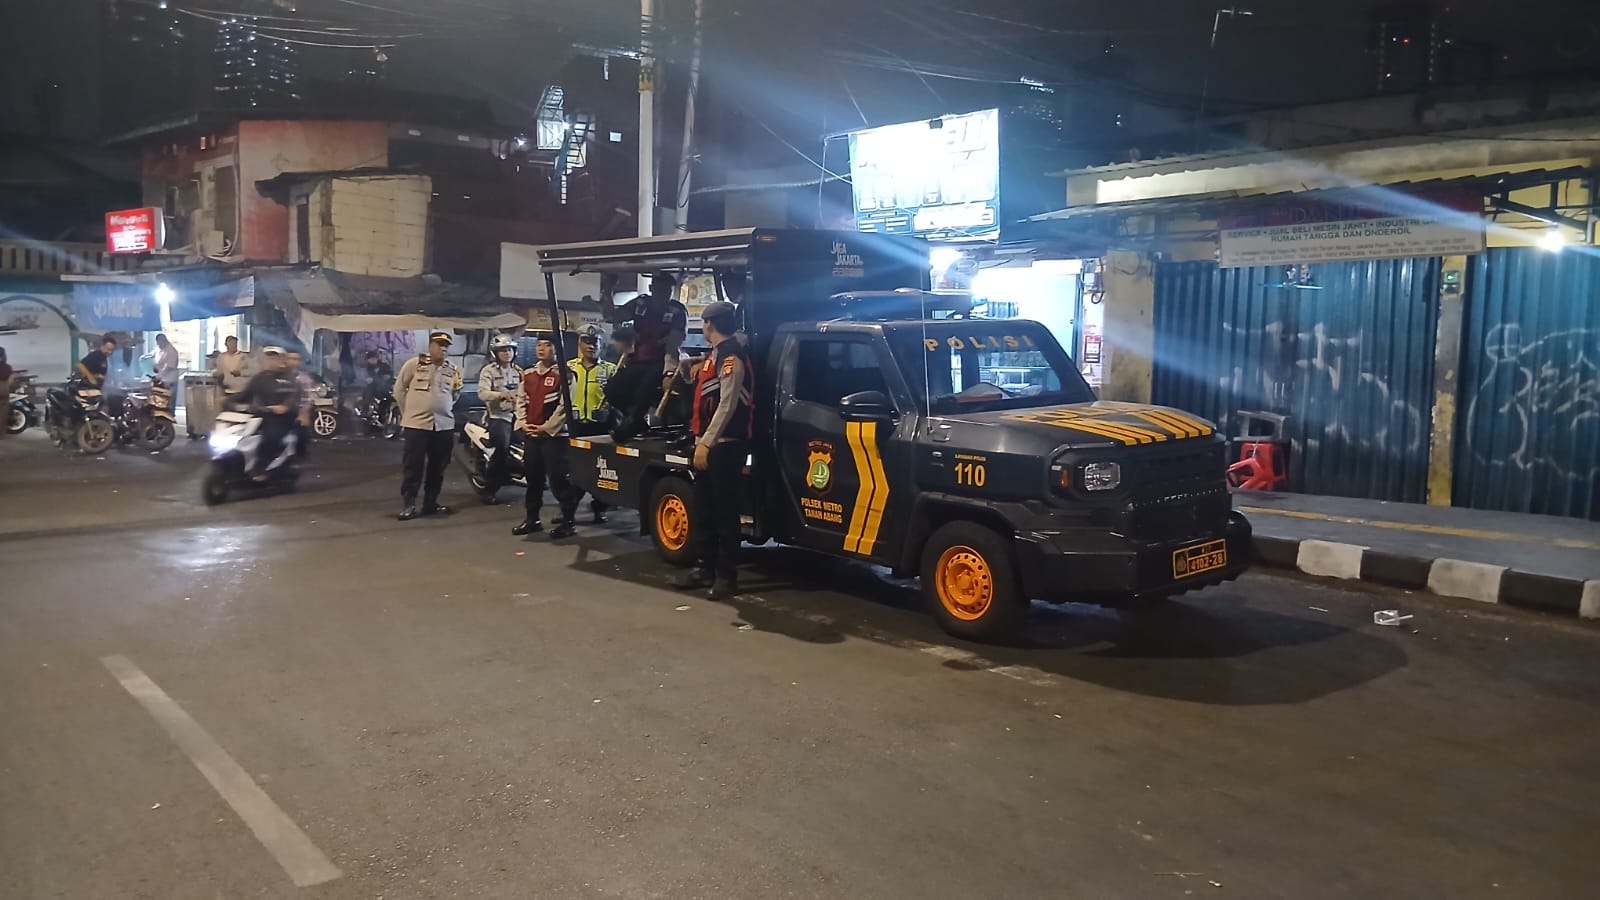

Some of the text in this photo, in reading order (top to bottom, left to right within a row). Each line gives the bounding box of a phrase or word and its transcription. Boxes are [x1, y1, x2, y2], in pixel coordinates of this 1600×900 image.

[1292, 225, 1312, 234] BELI
[1313, 223, 1340, 232] MESIN
[1343, 221, 1368, 230] JAHIT
[1375, 219, 1420, 228] INDUSTRI
[1271, 228, 1412, 243] RUMAH TANGGA DAN ONDERDIL
[924, 335, 1034, 352] POLISI
[954, 462, 986, 487] 110
[801, 497, 843, 513] POLSEK METRO
[805, 508, 843, 523] TANAH ABANG
[1191, 552, 1224, 570] 4102-28
